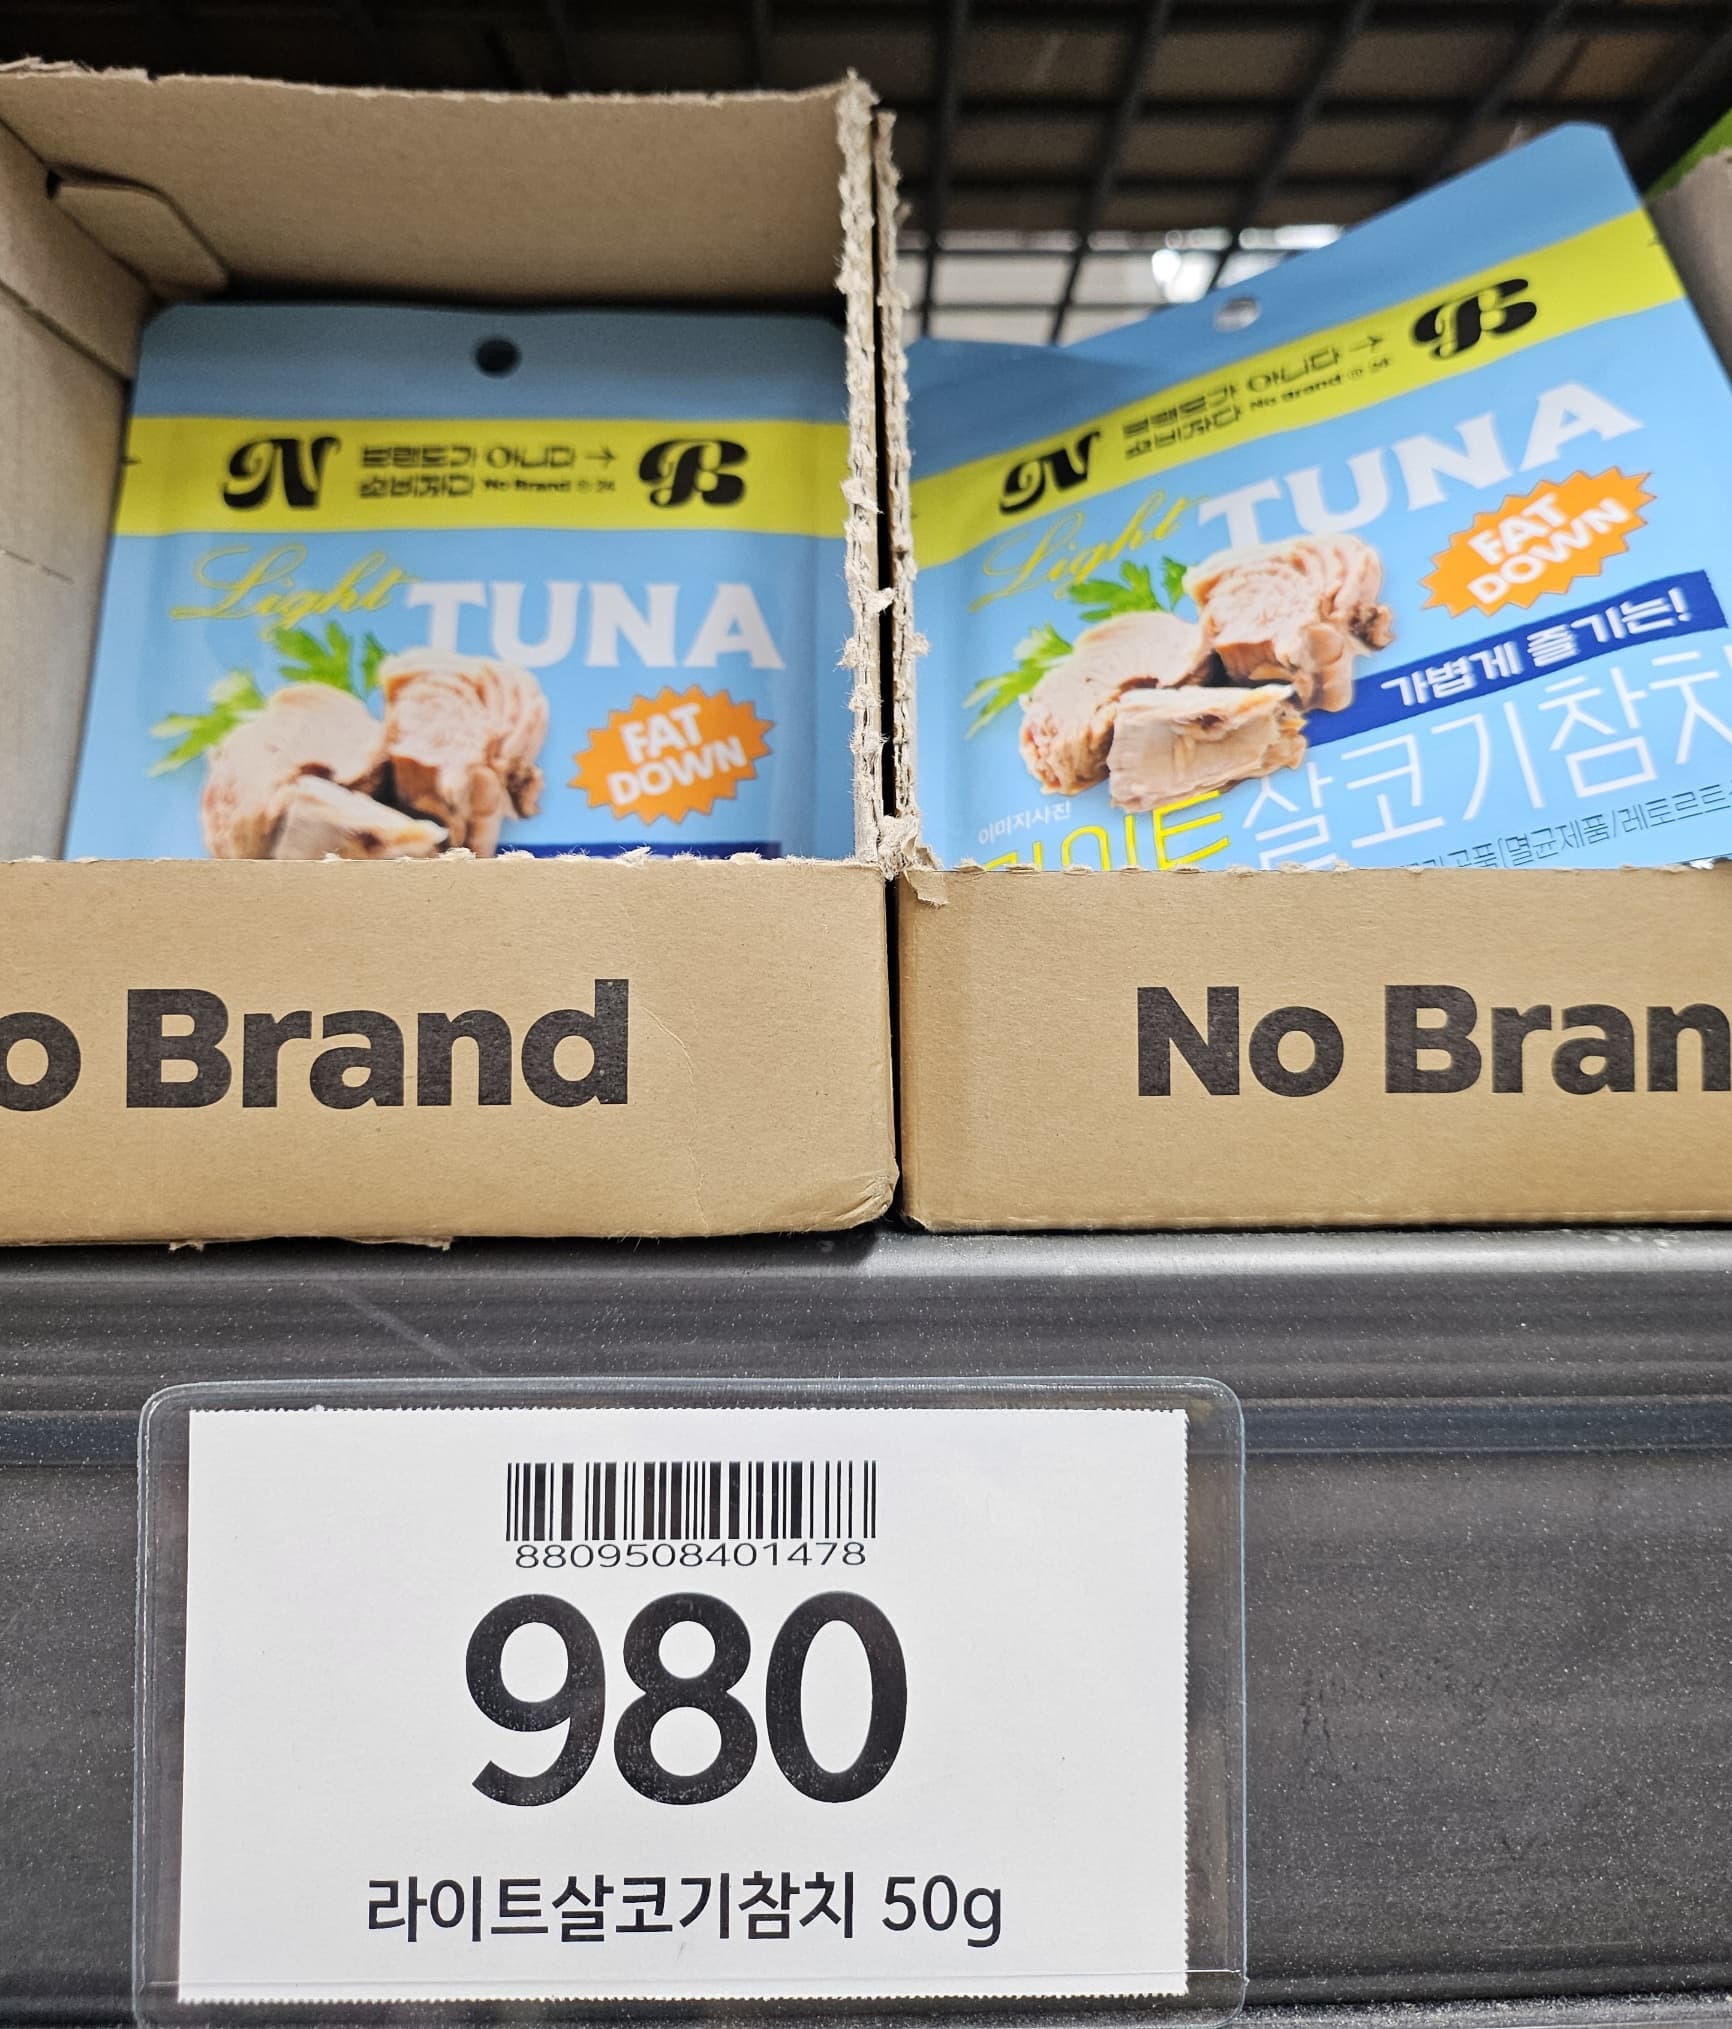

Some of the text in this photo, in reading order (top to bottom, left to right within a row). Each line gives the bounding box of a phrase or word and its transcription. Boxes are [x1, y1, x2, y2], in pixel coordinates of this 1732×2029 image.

[1412, 278, 1537, 359] B
[1246, 346, 1340, 393] 아니다
[222, 435, 343, 510] N
[486, 446, 576, 469] 아니다
[637, 437, 750, 509] B
[1000, 431, 1100, 515] N
[967, 383, 1647, 613] Light TUNA
[1467, 491, 1567, 566] FAT
[1467, 497, 1631, 605] DOWN
[171, 543, 785, 670] Light TUNA
[1380, 587, 1692, 707] 가볍게 즐기는!
[606, 736, 748, 806] DOWN
[619, 703, 703, 765] FAT
[978, 800, 1071, 845] 이미지사진
[0, 979, 628, 1111] o Brand
[1138, 985, 1731, 1097] No Bran
[515, 1541, 867, 1568] 8809508401478
[465, 1590, 908, 1807] 980
[369, 1871, 1002, 1948] 라이트살코기참치 50g
